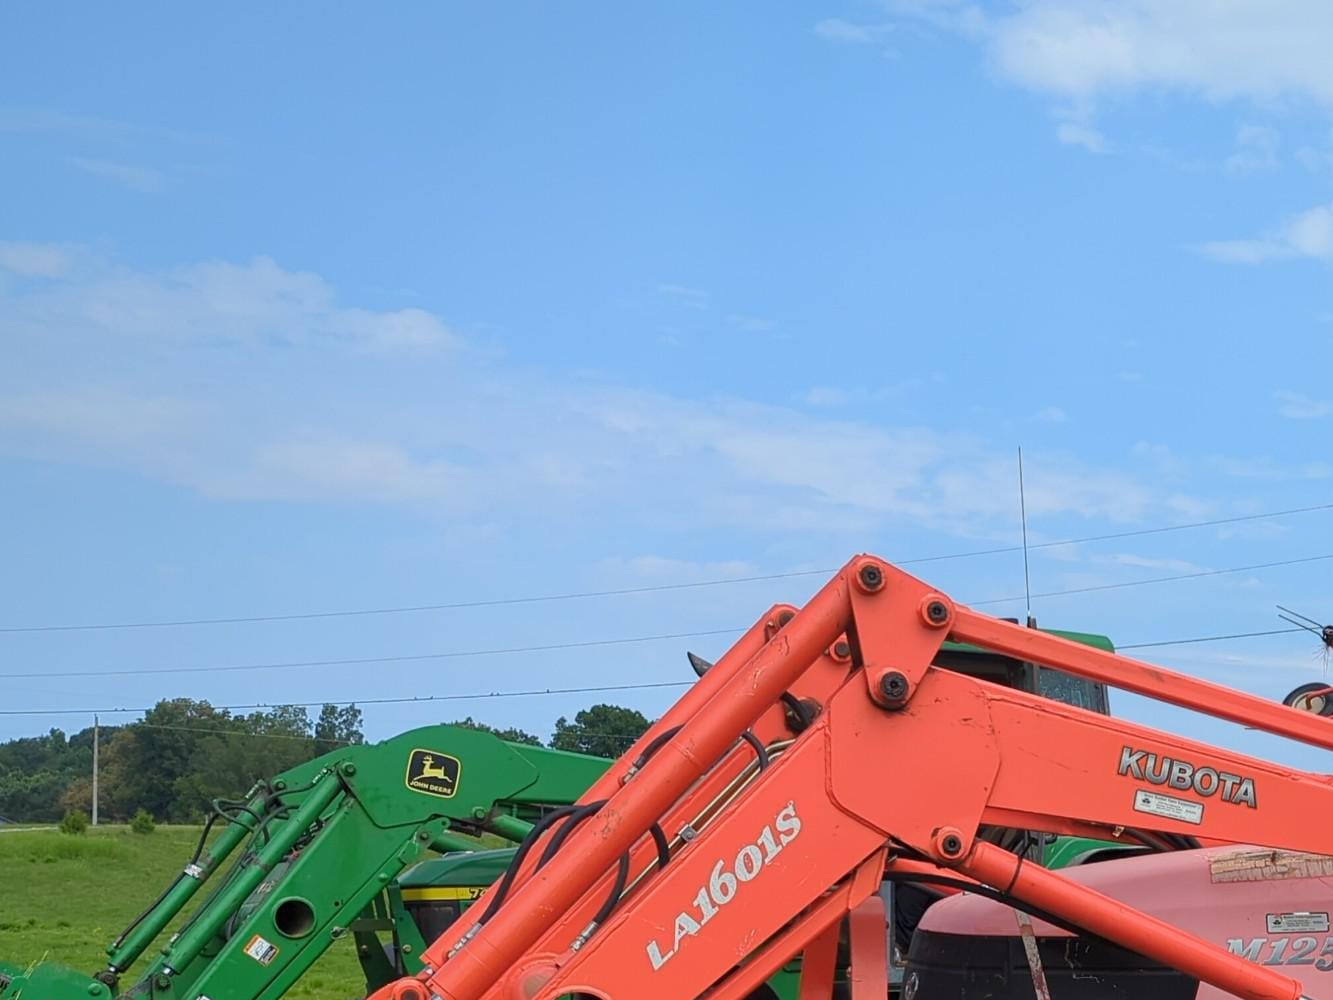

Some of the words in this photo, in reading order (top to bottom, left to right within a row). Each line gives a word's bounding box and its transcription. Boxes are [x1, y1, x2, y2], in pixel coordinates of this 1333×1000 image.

[410, 780, 429, 790] JOHN
[429, 784, 453, 795] DEERE
[1117, 745, 1258, 810] KUBOTA
[646, 799, 802, 971] LA1601S
